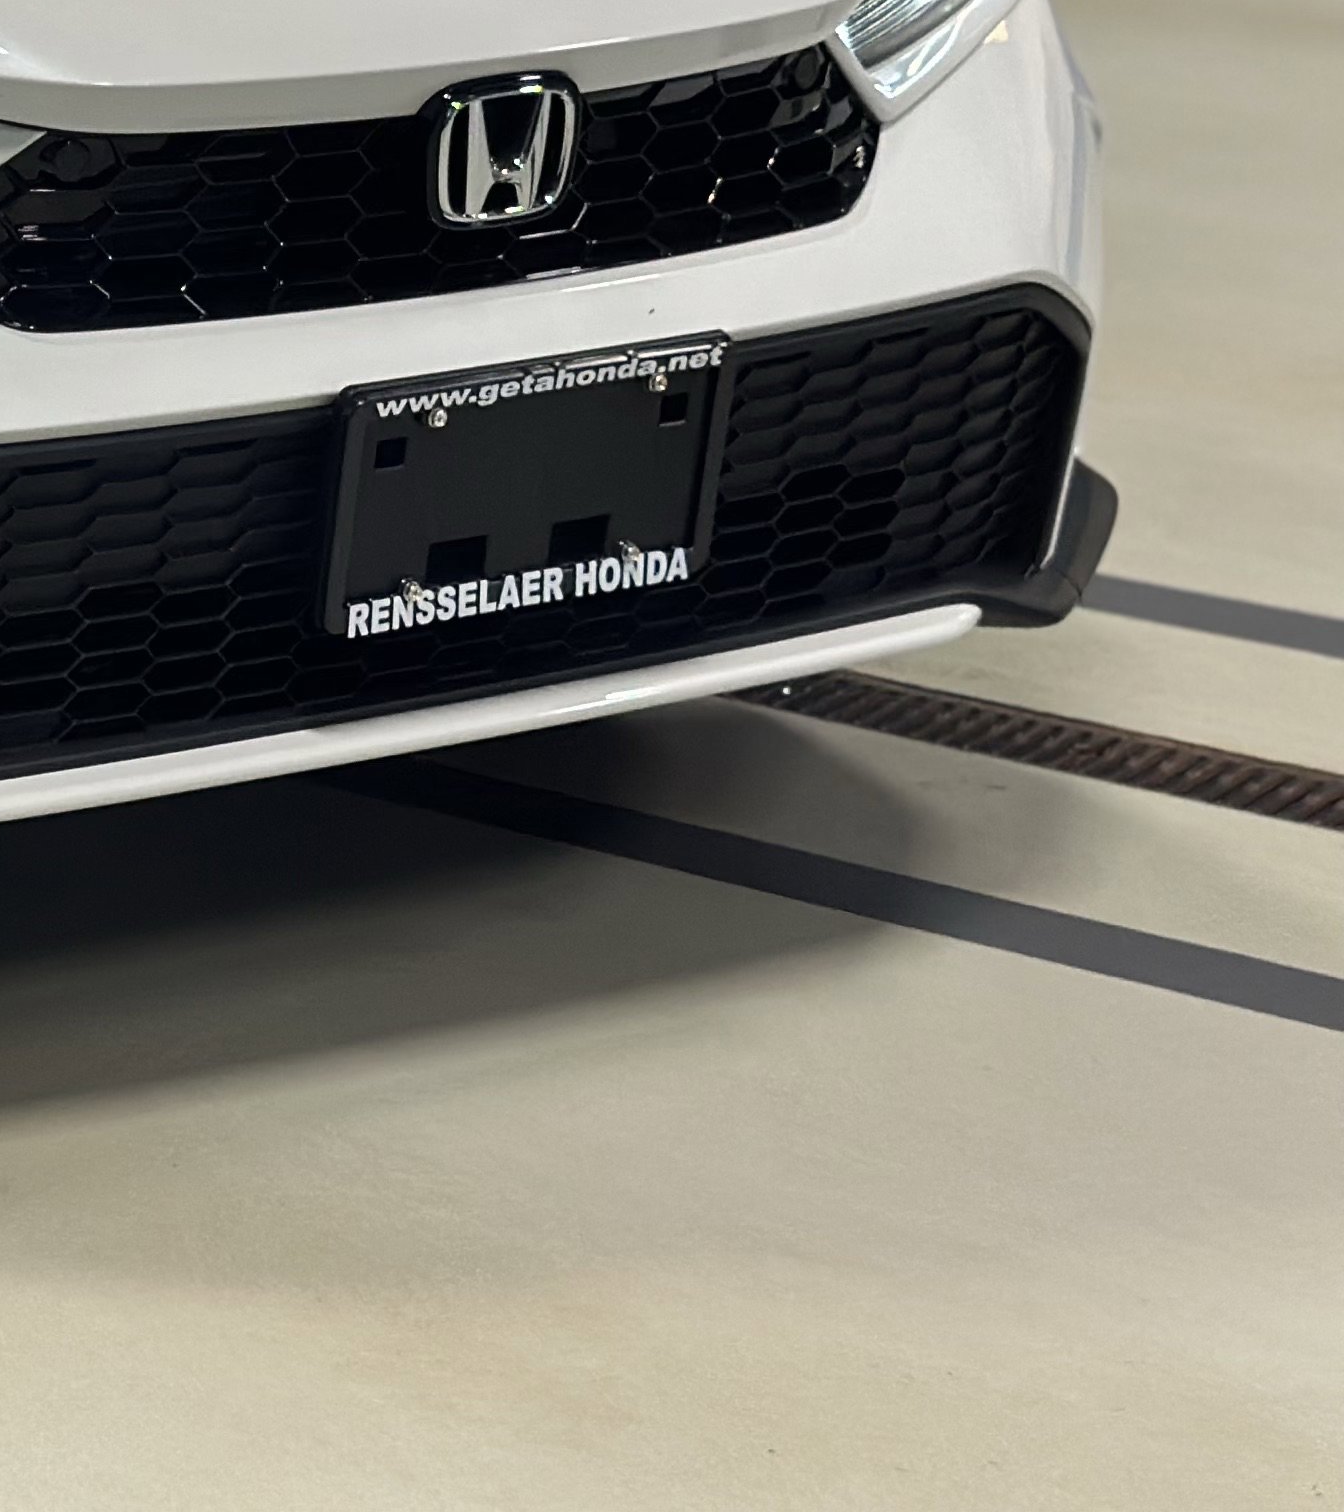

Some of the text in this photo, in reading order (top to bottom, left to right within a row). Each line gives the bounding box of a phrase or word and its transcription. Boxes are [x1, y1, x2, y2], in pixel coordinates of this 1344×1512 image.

[376, 345, 723, 418] www.getahonda.net
[347, 547, 688, 639] RENSSELAER HONDA
